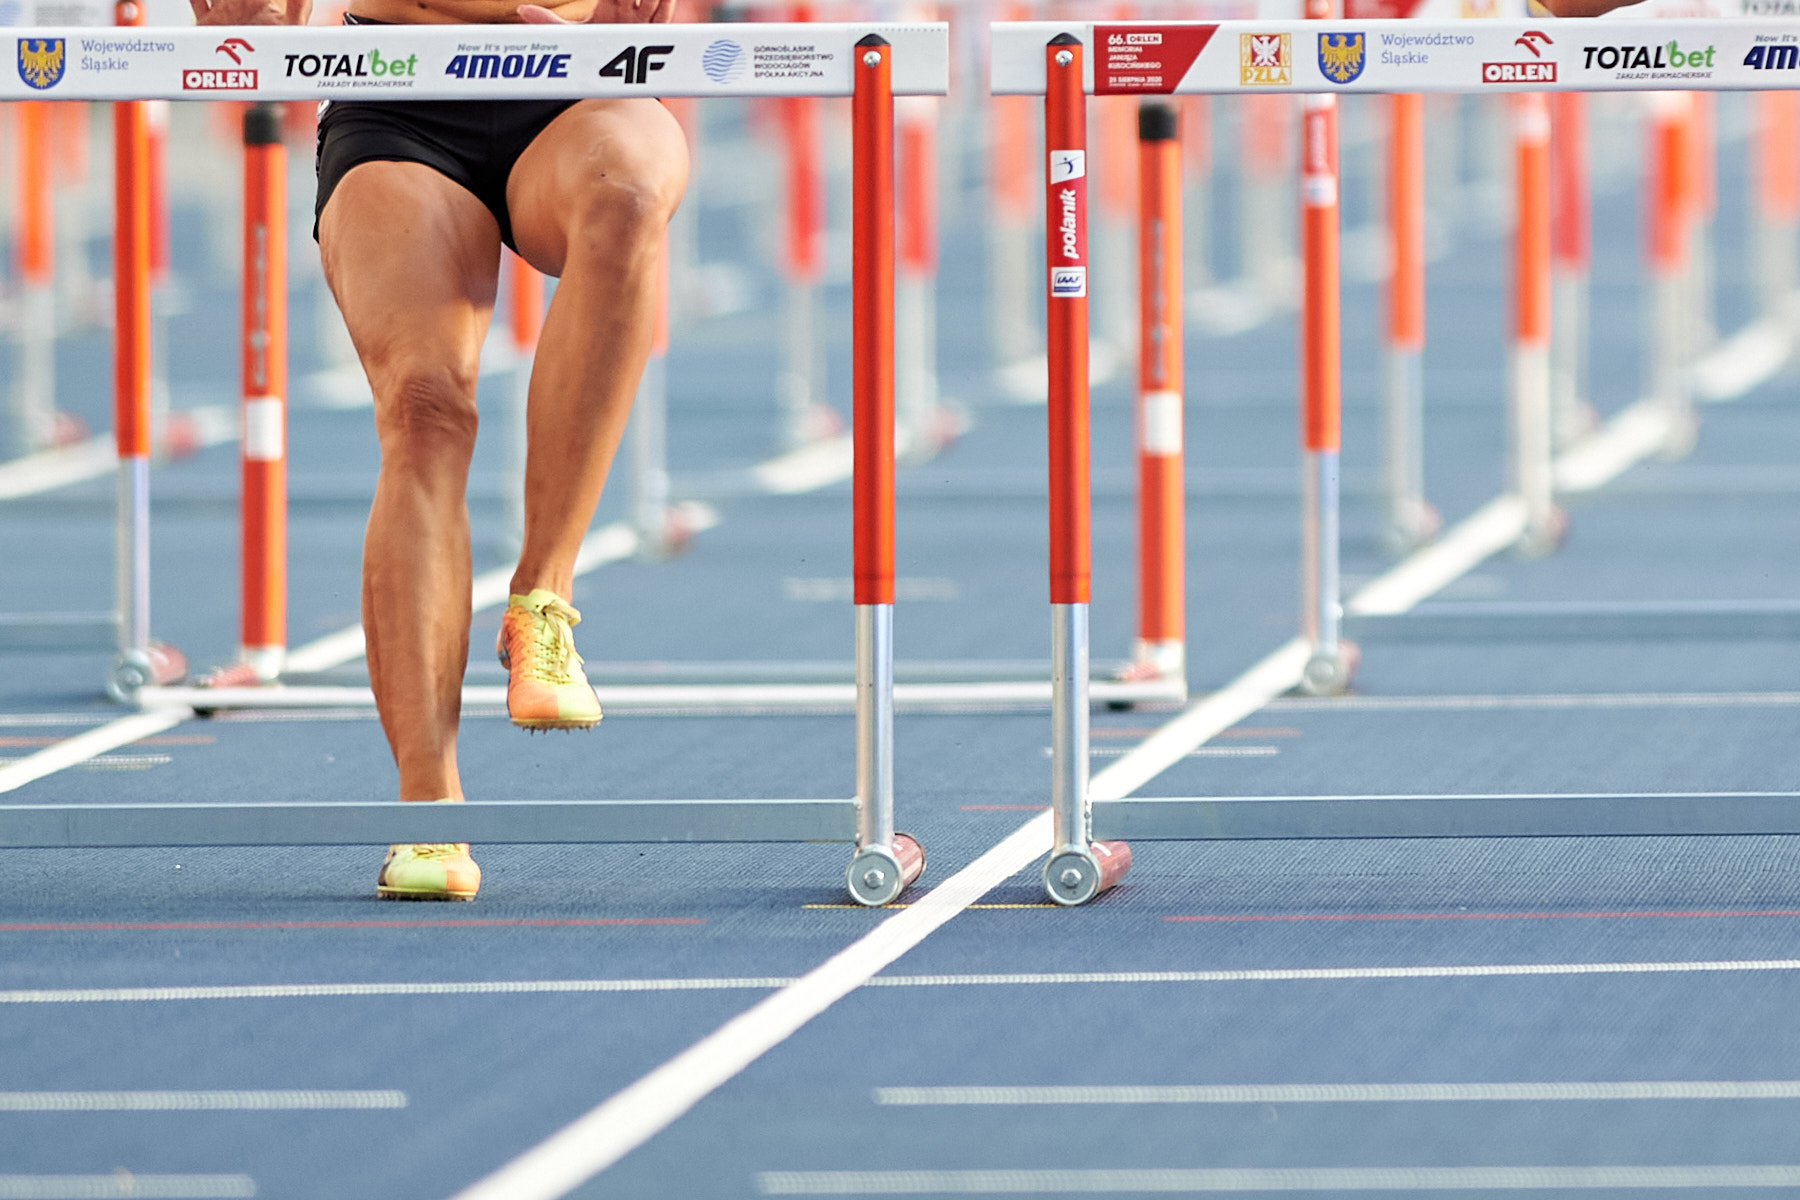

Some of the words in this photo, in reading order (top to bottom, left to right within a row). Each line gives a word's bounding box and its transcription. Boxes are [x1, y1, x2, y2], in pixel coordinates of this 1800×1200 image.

[1107, 34, 1126, 45] 66.
[1381, 33, 1474, 48] Województwo
[1754, 34, 1779, 42] Now
[1782, 34, 1798, 42] It's
[81, 39, 175, 55] Województwo
[457, 43, 481, 51] Now
[484, 43, 500, 51] It's
[503, 44, 528, 53] your
[531, 42, 559, 51] Move
[1583, 40, 1716, 70] TOTALbet
[81, 56, 129, 72] Śląskie
[285, 48, 418, 77] TOTALbet
[599, 45, 675, 84] 4F
[1381, 50, 1429, 66] Śląskie
[445, 54, 572, 79] 4MOVE
[1485, 64, 1554, 82] ORLEN
[185, 71, 254, 89] ORLEN
[1243, 67, 1290, 83] PZLA
[1059, 188, 1080, 260] polanik
